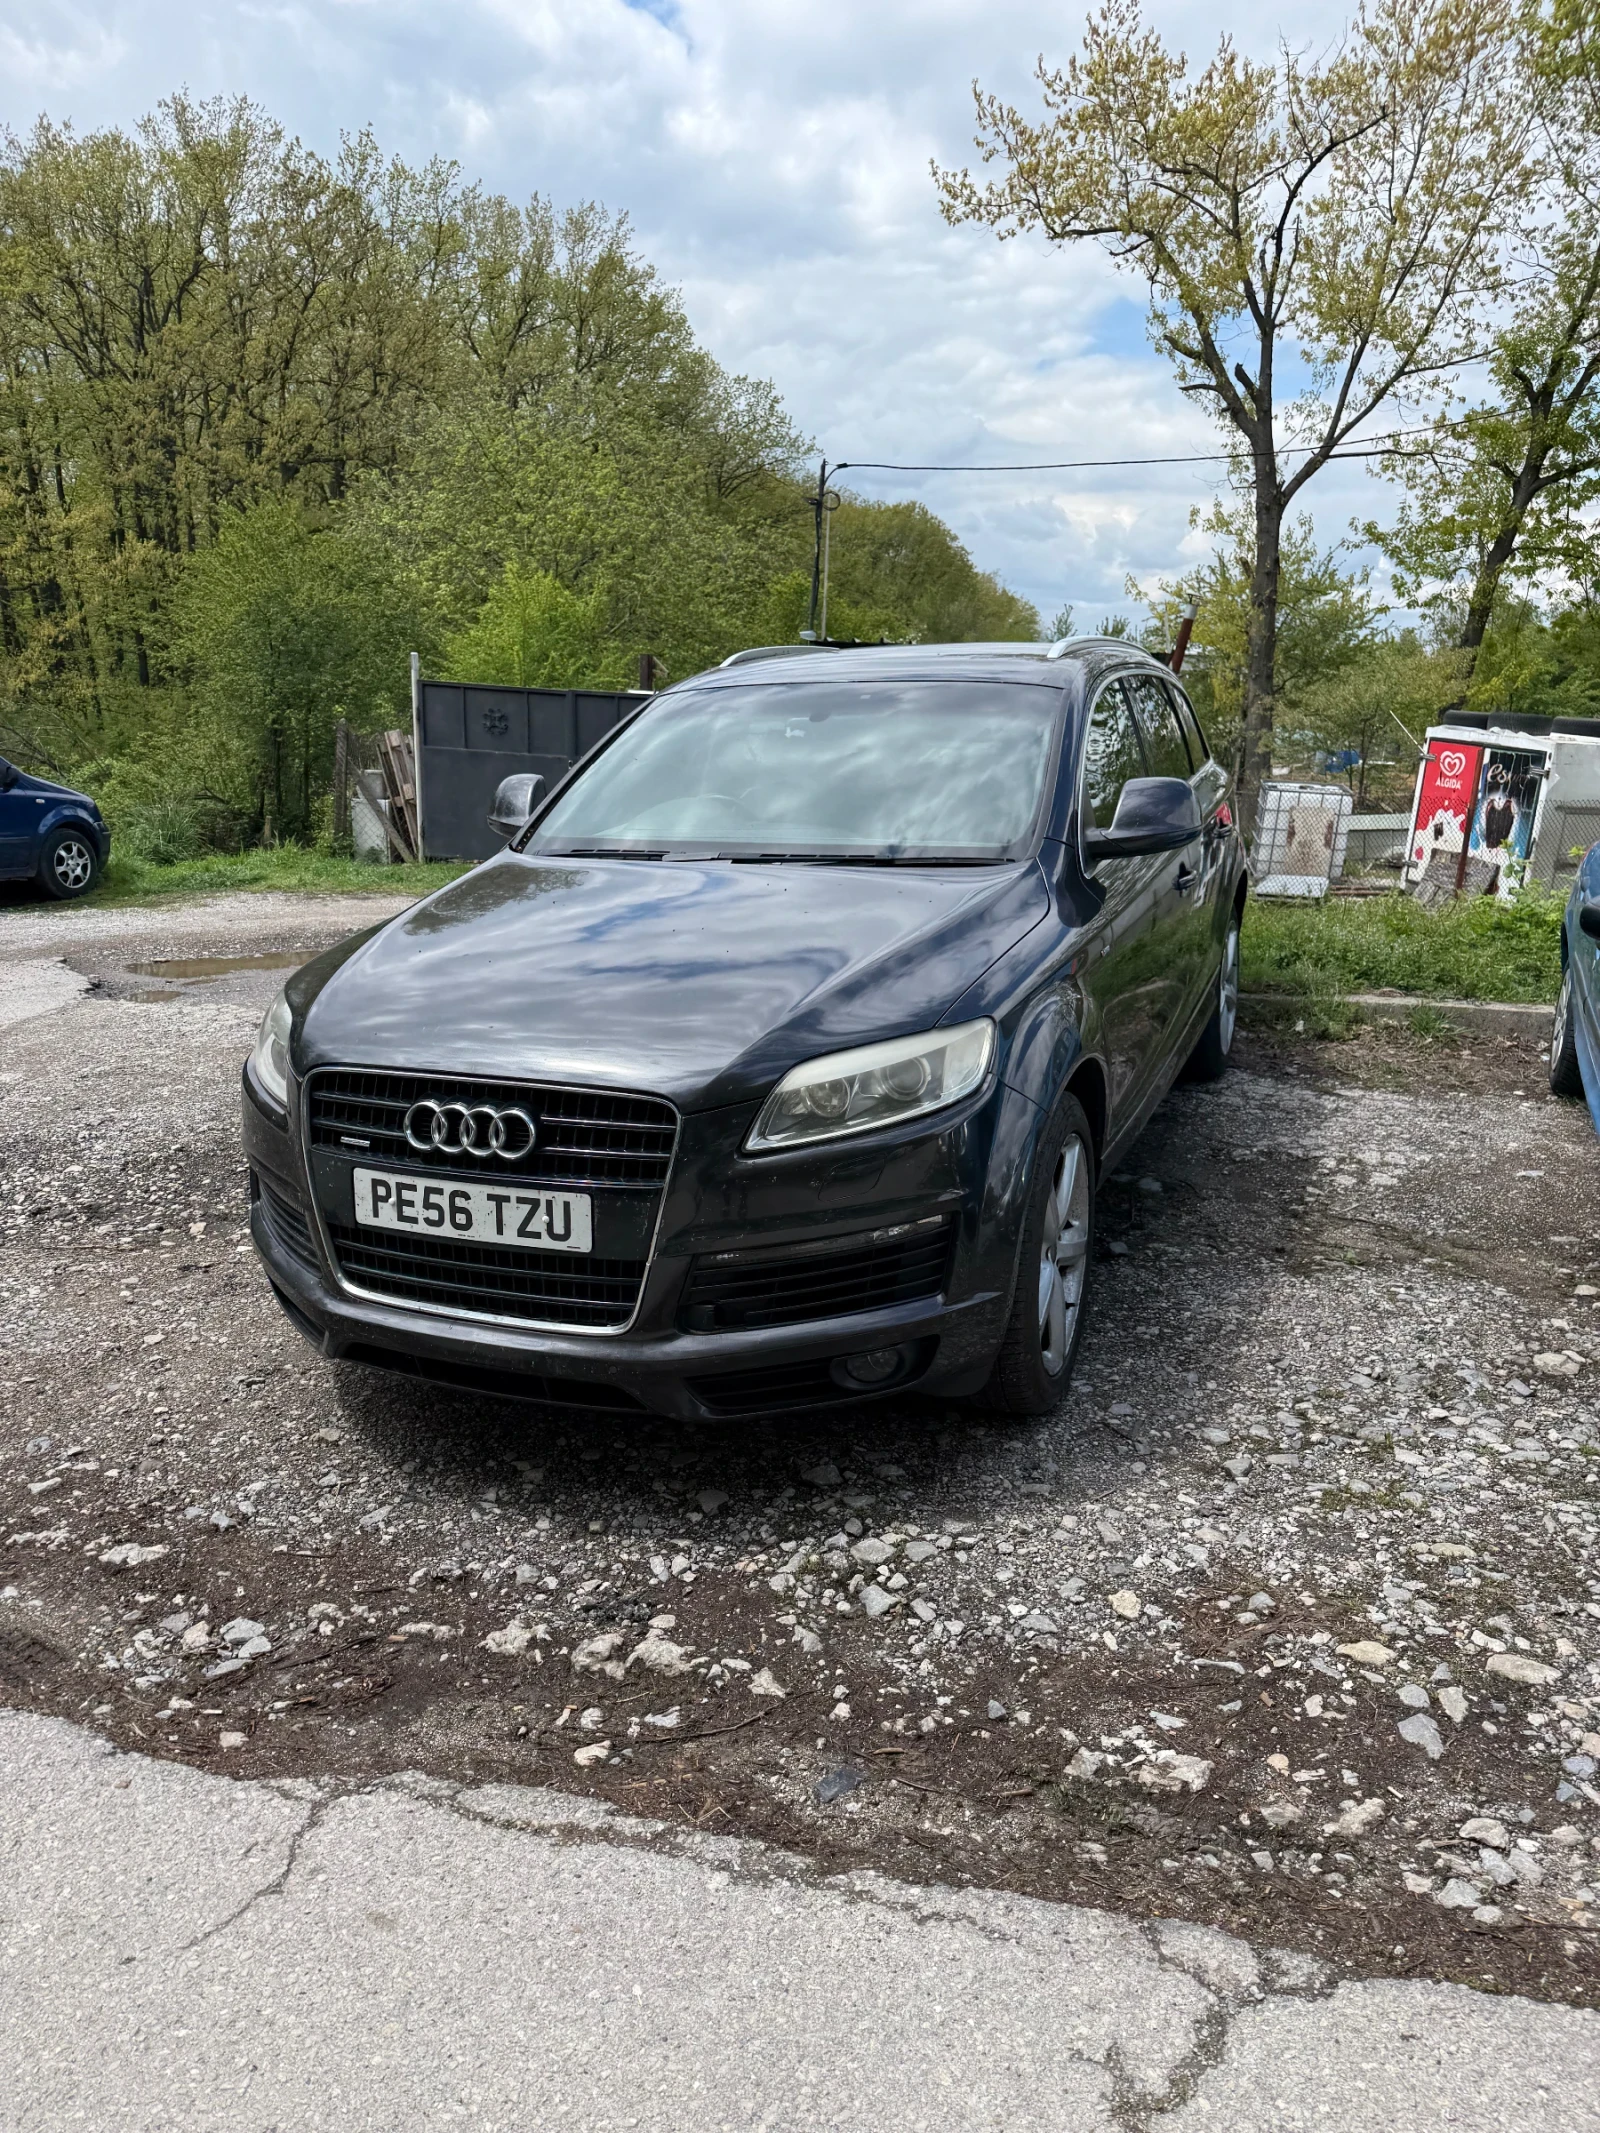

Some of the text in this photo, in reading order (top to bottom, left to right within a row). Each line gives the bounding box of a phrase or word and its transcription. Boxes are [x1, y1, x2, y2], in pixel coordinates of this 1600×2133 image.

[1435, 776, 1461, 790] ALGIDA
[371, 1178, 572, 1242] PE56 TZU
